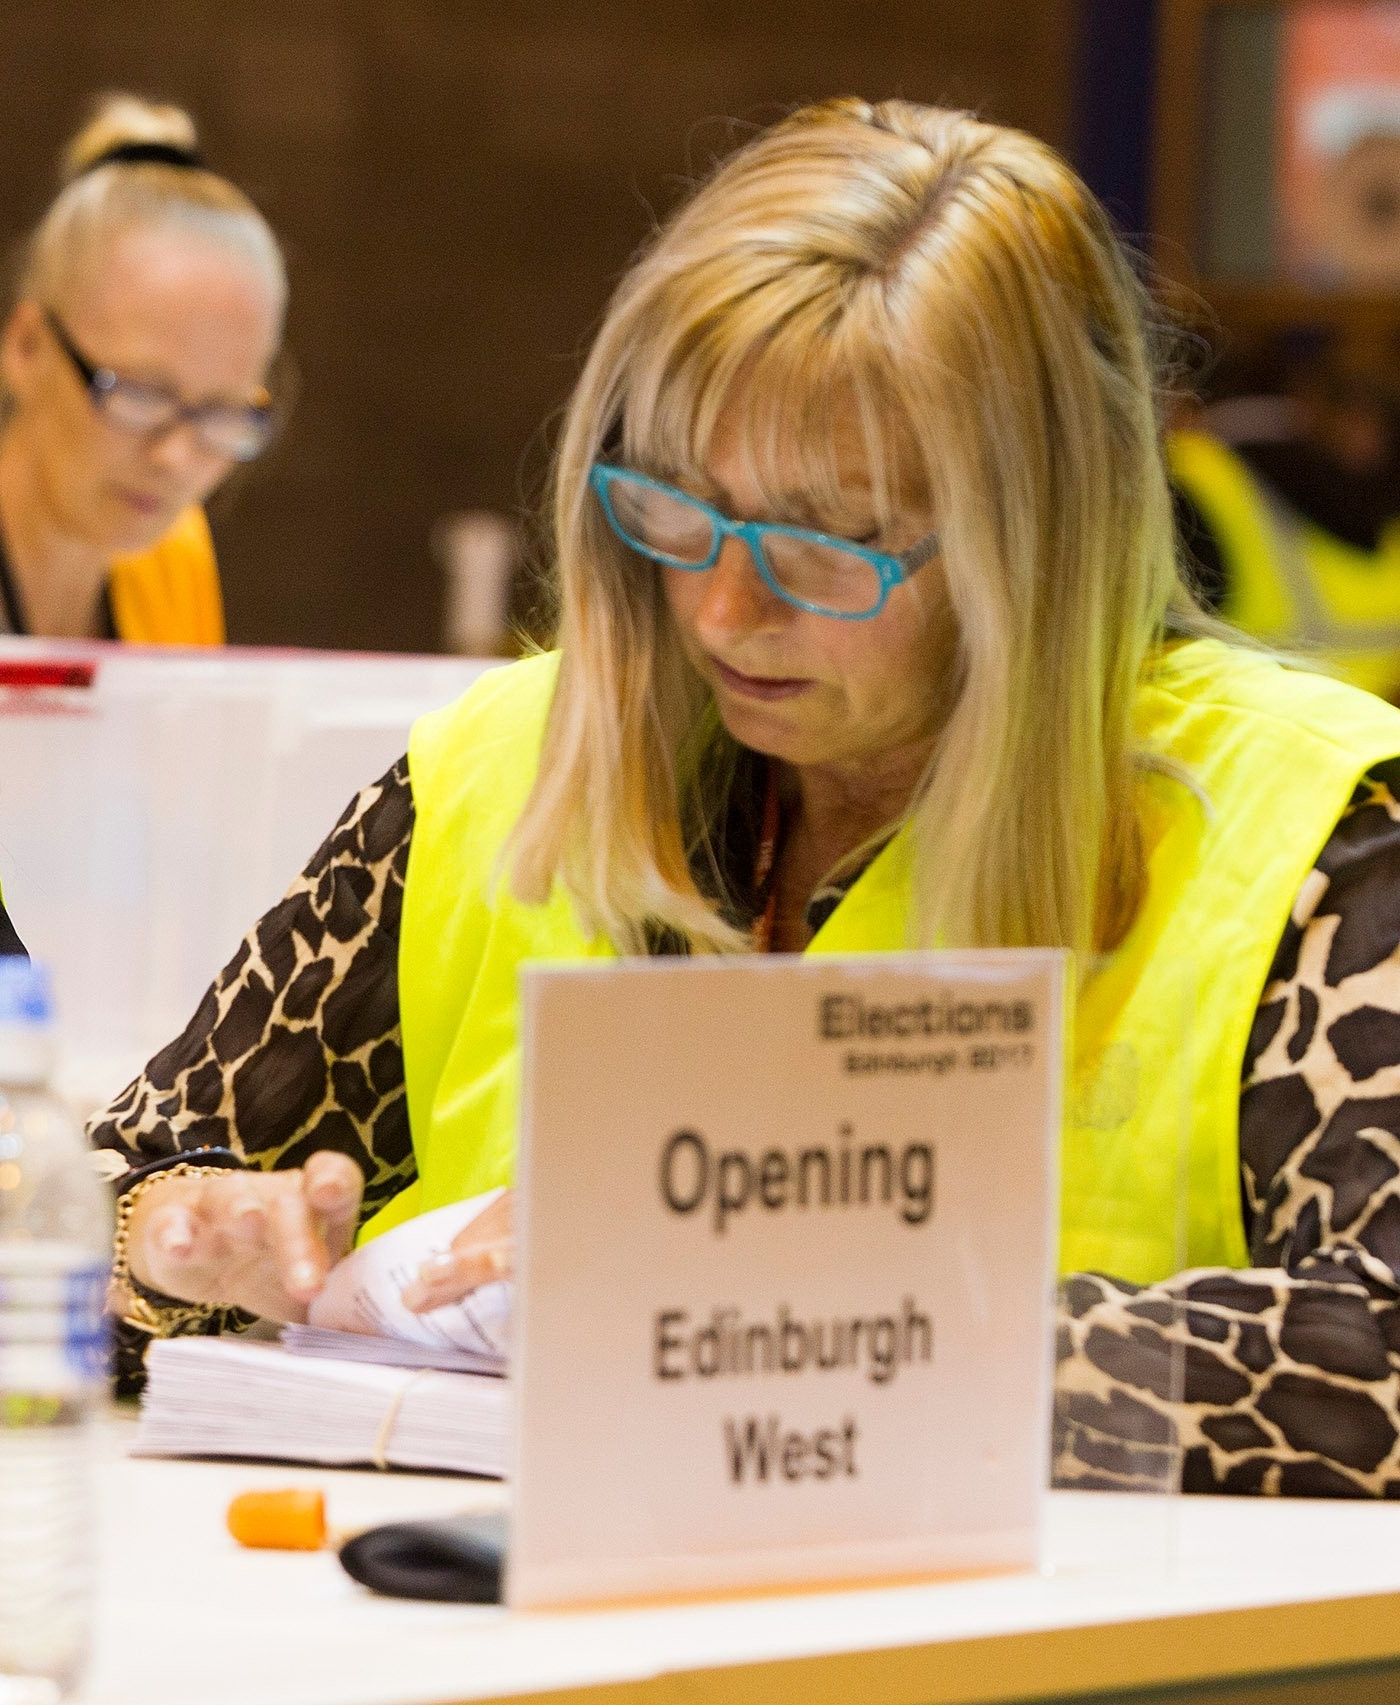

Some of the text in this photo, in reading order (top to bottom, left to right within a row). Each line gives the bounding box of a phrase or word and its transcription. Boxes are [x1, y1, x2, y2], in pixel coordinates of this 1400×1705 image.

[819, 989, 1034, 1040] Elections
[658, 1122, 936, 1233] Opening
[654, 1296, 934, 1385] Edinburgh
[724, 1411, 860, 1484] West
